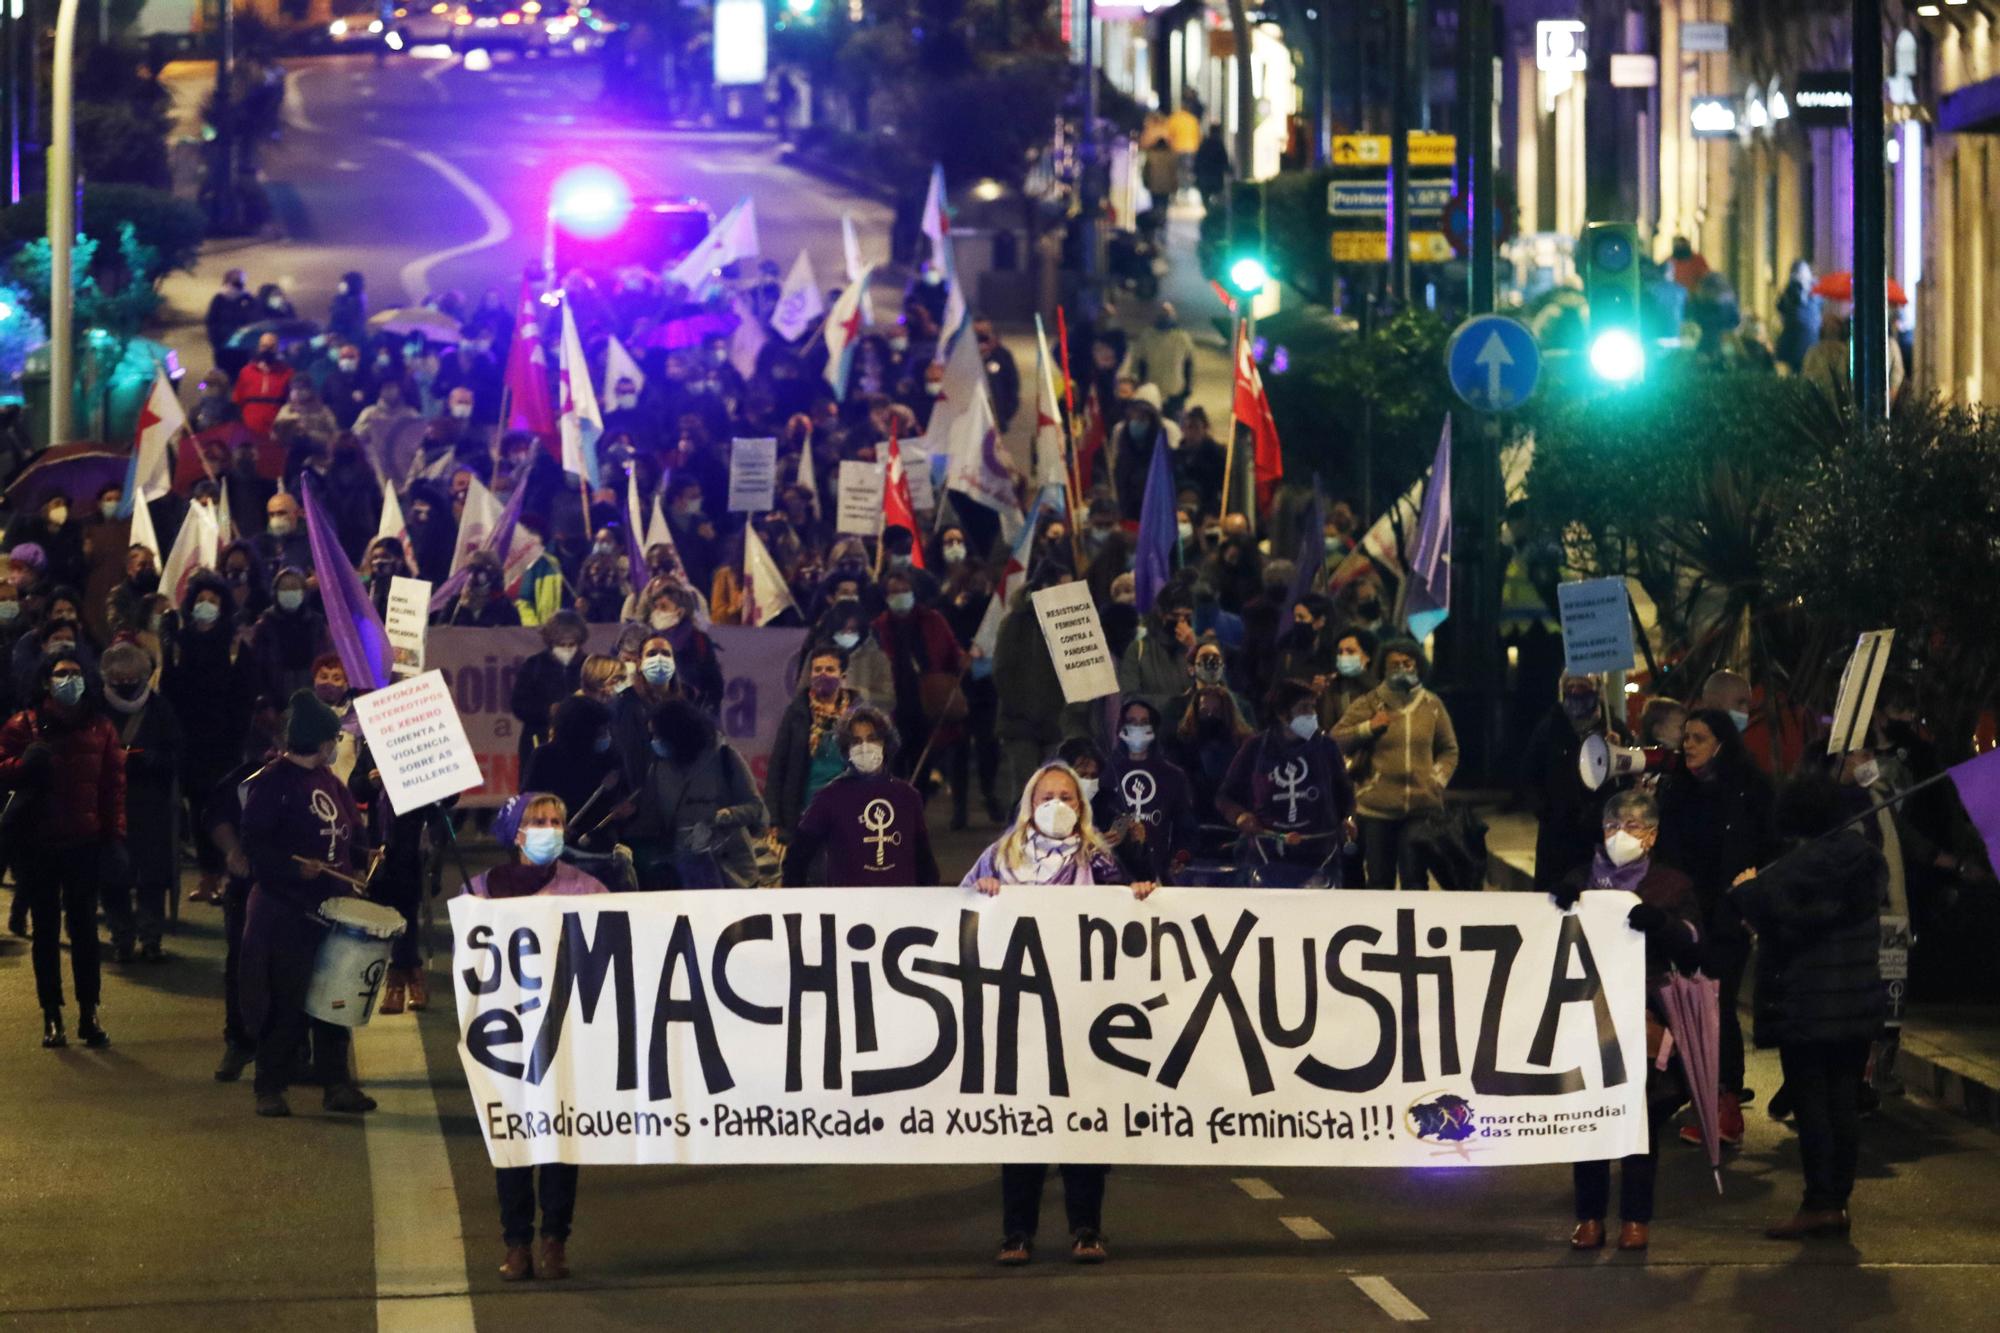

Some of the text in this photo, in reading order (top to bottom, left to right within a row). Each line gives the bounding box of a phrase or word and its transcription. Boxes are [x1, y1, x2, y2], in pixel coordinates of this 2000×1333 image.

[1046, 603, 1091, 618] RESISTENCIA
[1055, 617, 1091, 630] FEMINISTA
[1060, 631, 1087, 644] CONTRA
[1064, 644, 1098, 657] PANDEMIA
[368, 693, 443, 724] ESTEREOTIPOS
[381, 708, 441, 736] DE XENERO
[386, 722, 446, 748] CIMENTA A
[392, 736, 450, 761] VIOLENCIA
[399, 750, 453, 774] SOBRE AS
[402, 763, 460, 789] MULLERES
[1079, 914, 1196, 982] non
[900, 1106, 934, 1135] da
[1067, 1107, 1108, 1132] coa
[1124, 1102, 1194, 1138] Loita
[1480, 1104, 1627, 1125] marcha mundial
[1480, 1121, 1598, 1138] das mulleres
